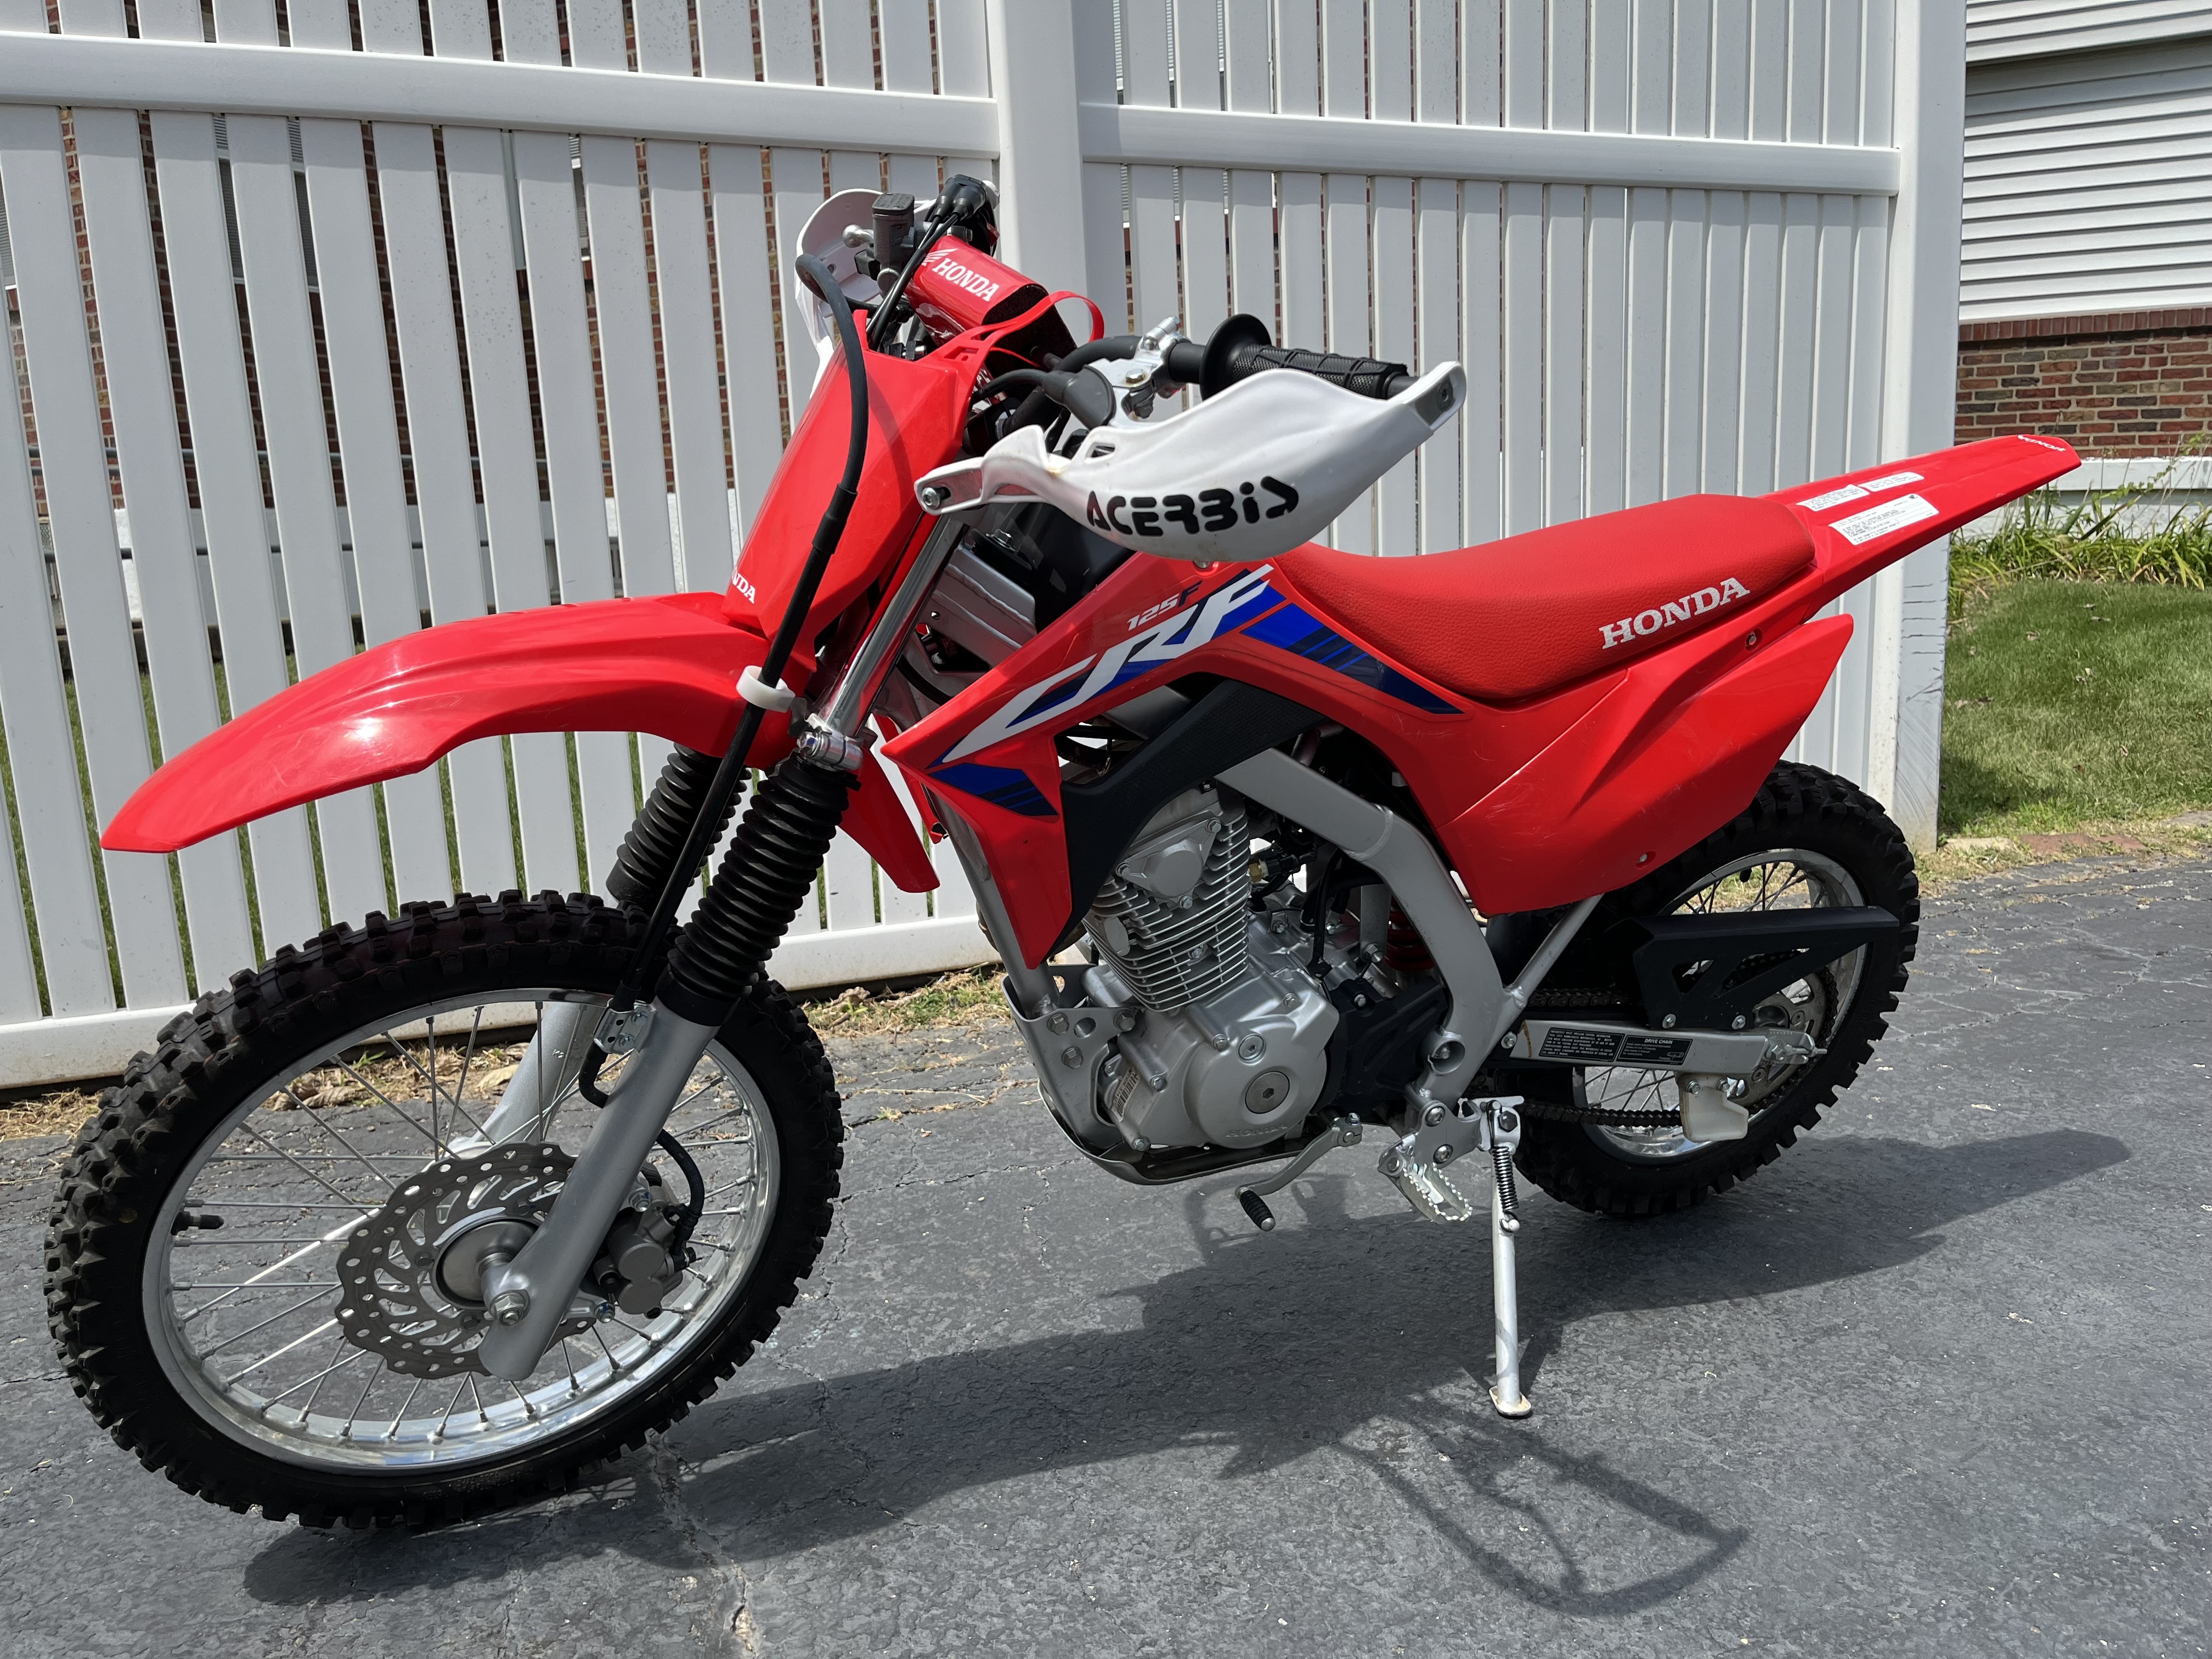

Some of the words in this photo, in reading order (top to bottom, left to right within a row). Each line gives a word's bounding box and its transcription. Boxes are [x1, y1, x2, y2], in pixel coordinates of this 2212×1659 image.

[932, 257, 1000, 302] HONDA
[1126, 580, 1203, 631] 125F
[1599, 577, 1750, 650] HONDA
[943, 563, 1274, 763] CRF
[1224, 1124, 1288, 1137] HONDA
